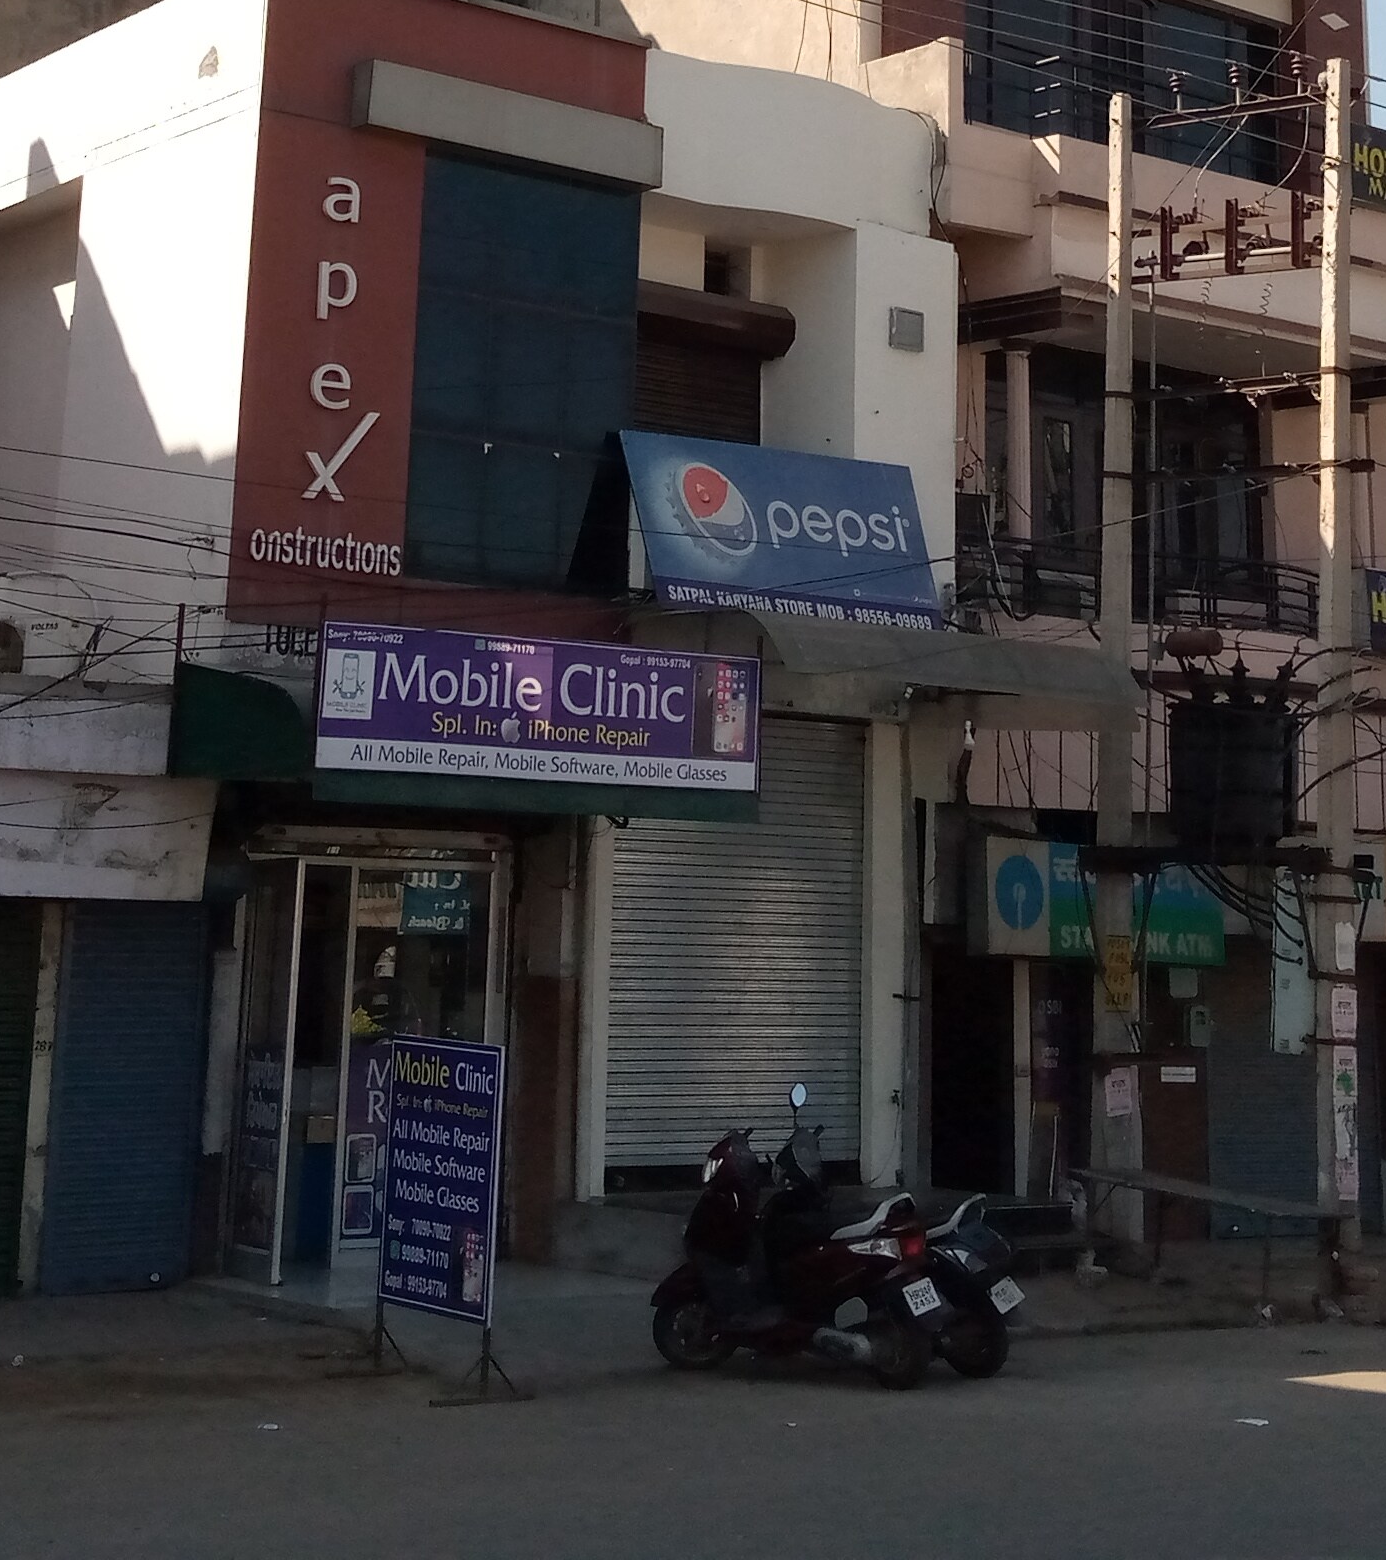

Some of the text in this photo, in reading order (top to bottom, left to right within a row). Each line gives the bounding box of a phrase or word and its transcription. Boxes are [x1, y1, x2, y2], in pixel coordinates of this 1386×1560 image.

[300, 175, 381, 502] apex
[766, 500, 909, 558] pepsi
[249, 524, 402, 578] onstructions
[667, 584, 933, 631] SATPAL KARYANA STORE MOB 98556-09689
[377, 652, 687, 724] Mobile Clinic
[431, 711, 651, 750] Spl. In: iPhone Repair
[350, 743, 728, 783] All Mobile Repair, Mobile Software, Mobile Glasses
[1176, 931, 1214, 959] ATM
[393, 1050, 494, 1095] Mobile Clinic
[462, 1103, 489, 1119] Repair
[392, 1118, 490, 1155] All Mobile Repair
[393, 1148, 486, 1183] Mobile Software
[395, 1178, 480, 1213] Mobile Glasses
